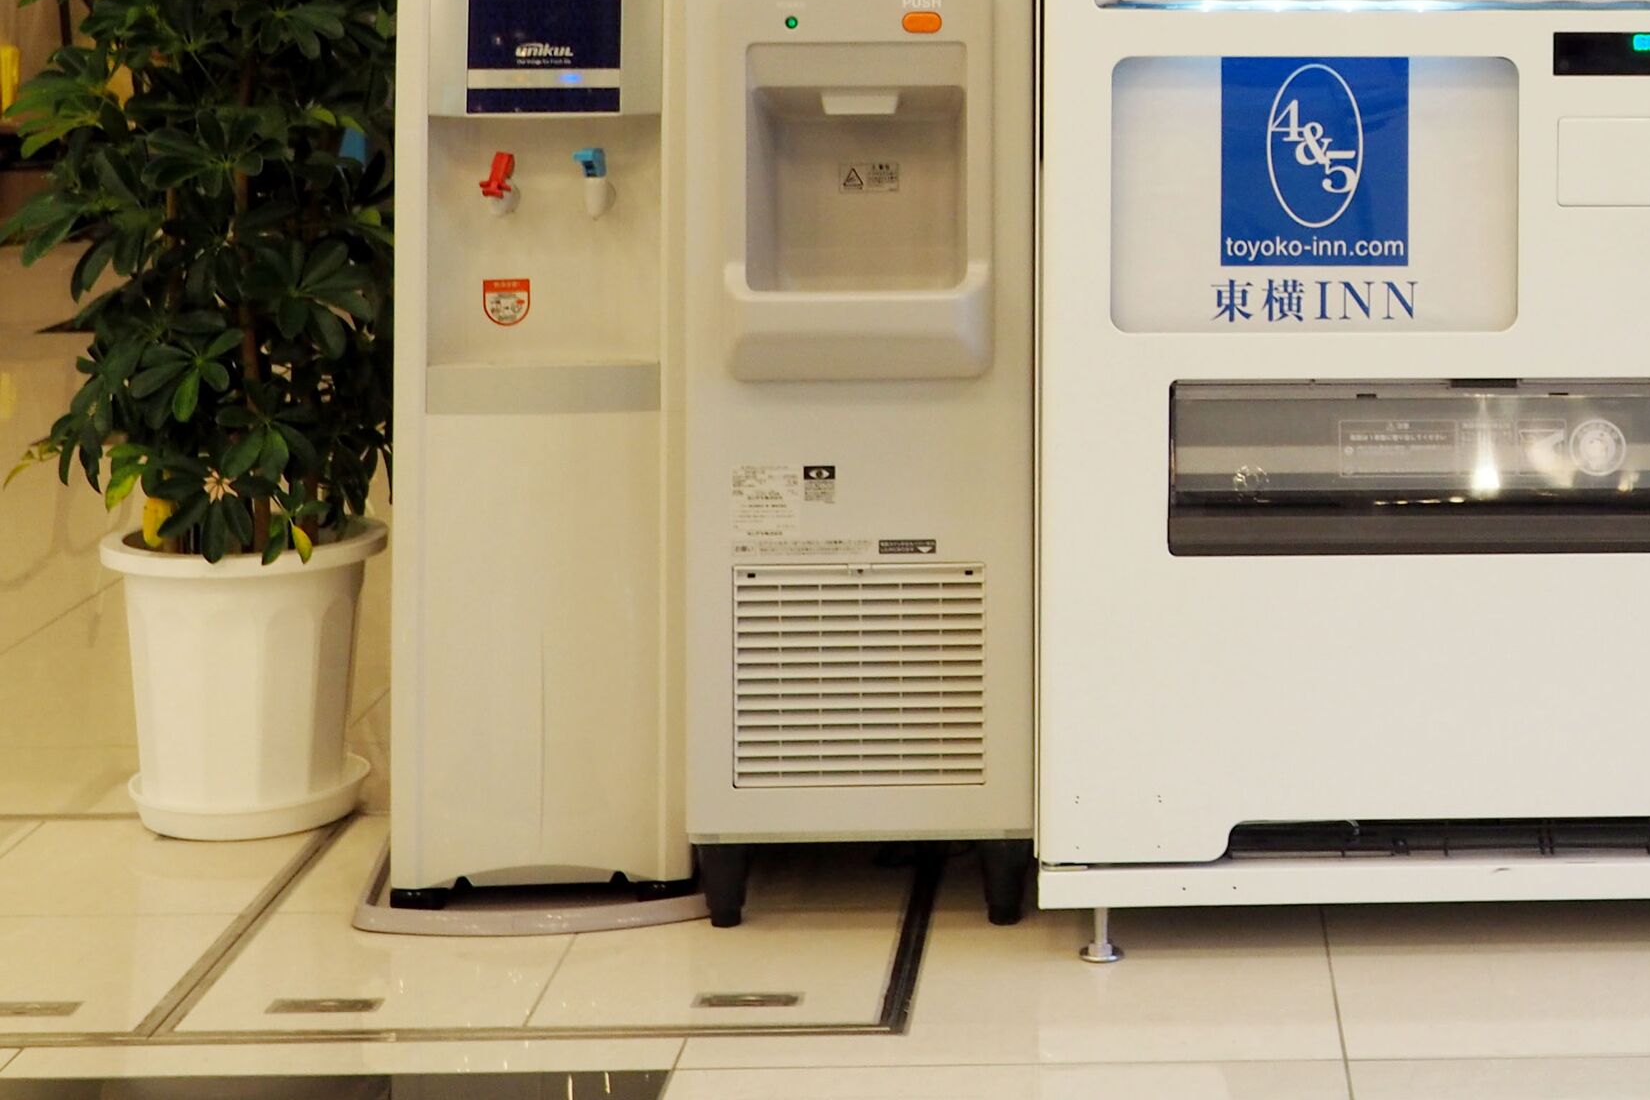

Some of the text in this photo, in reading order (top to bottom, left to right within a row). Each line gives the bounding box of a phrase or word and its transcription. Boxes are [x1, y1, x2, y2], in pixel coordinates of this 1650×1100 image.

[1271, 99, 1358, 194] 4&5
[1226, 236, 1404, 261] toyoko-inn.com
[1210, 278, 1419, 323] 東横INN
